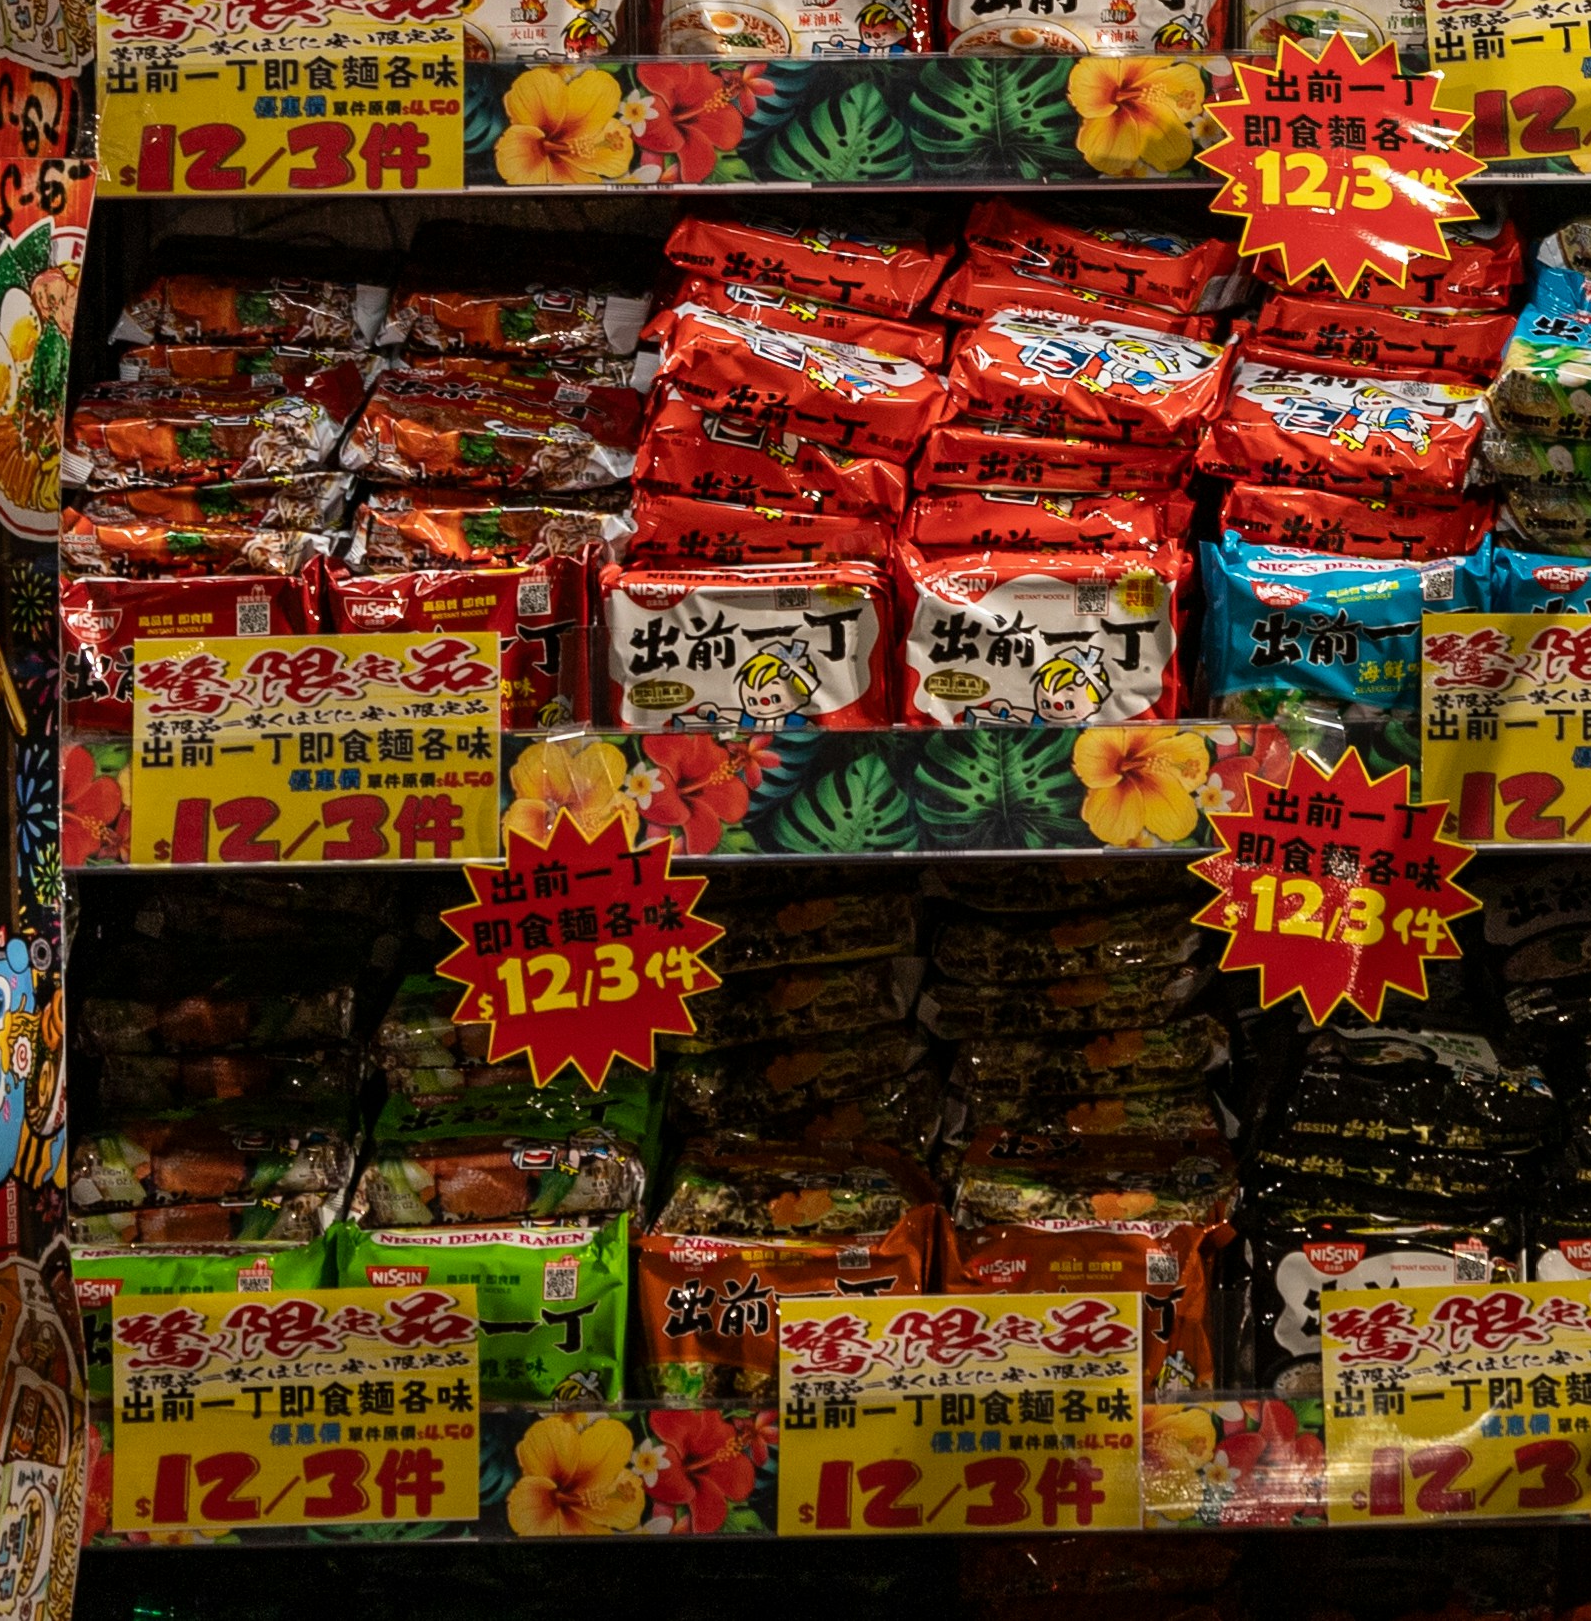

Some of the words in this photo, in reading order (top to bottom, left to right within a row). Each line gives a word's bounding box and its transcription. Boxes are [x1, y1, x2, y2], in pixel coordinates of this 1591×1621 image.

[107, 57, 457, 94] 出前一丁即食麵各味
[1266, 70, 1422, 107] 出前一丁
[630, 609, 861, 673] 出前一丁
[929, 610, 1159, 671] 出前一丁
[142, 729, 492, 768] 出前一丁即食麵各味
[1265, 790, 1430, 840] 出前一丁
[490, 848, 651, 906] 出前一丁
[473, 897, 684, 958] 即食麵各味
[449, 1232, 513, 1245] DEMAE
[519, 1231, 587, 1245] RAMEN
[1310, 1248, 1358, 1262] NISSIN
[122, 1381, 472, 1424] 出前一丁即食麵各味
[785, 1389, 1133, 1430] 出前一丁即食麵各味
